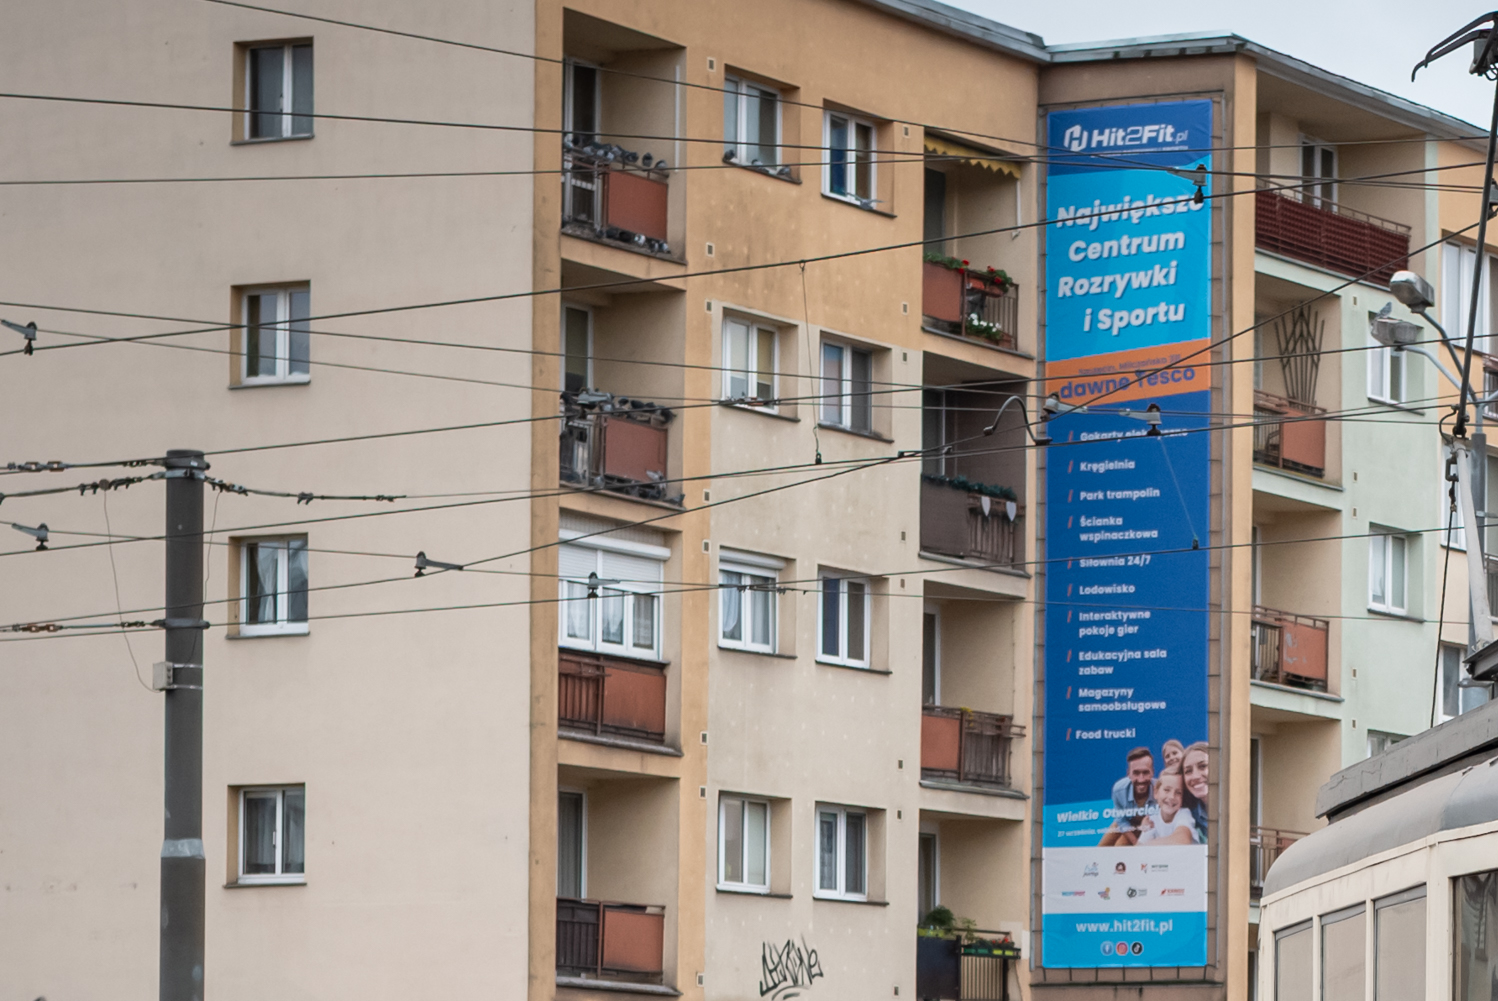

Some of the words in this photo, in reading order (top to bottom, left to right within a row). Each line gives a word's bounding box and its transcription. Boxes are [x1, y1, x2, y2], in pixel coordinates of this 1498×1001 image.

[1091, 123, 1188, 148] Hit2Fit.pl
[1069, 231, 1186, 262] Centrum
[1058, 261, 1178, 299] Rozrywki
[1083, 308, 1093, 332] i
[1098, 302, 1186, 336] Sportu
[1060, 376, 1130, 399] dawne
[1135, 367, 1196, 389] Tesco
[1080, 459, 1136, 473] Kręgielnia
[1080, 491, 1104, 501] Park
[1106, 487, 1160, 501] trampolin
[1080, 515, 1123, 527] Ścianka
[1079, 530, 1158, 543] wspinaczkowa
[1079, 556, 1126, 568] Siłownia
[1127, 554, 1151, 567] 24/7
[1079, 583, 1136, 595] Lodowisko
[1079, 610, 1151, 622] Interaktywne
[1079, 625, 1115, 638] pokoje
[1117, 624, 1139, 637] gier
[1078, 649, 1142, 662] Edukacyjna
[1143, 648, 1168, 659] sala
[1078, 665, 1114, 676] zabaw
[1078, 687, 1134, 700] Magazyny
[1078, 701, 1167, 713] samoobsługowe
[1075, 729, 1102, 740] Food
[1104, 728, 1136, 739] trucki
[1056, 809, 1099, 823] Wielkie
[1102, 803, 1160, 818] Otwarcie!
[1075, 919, 1173, 935] www.hit2fit.pl
